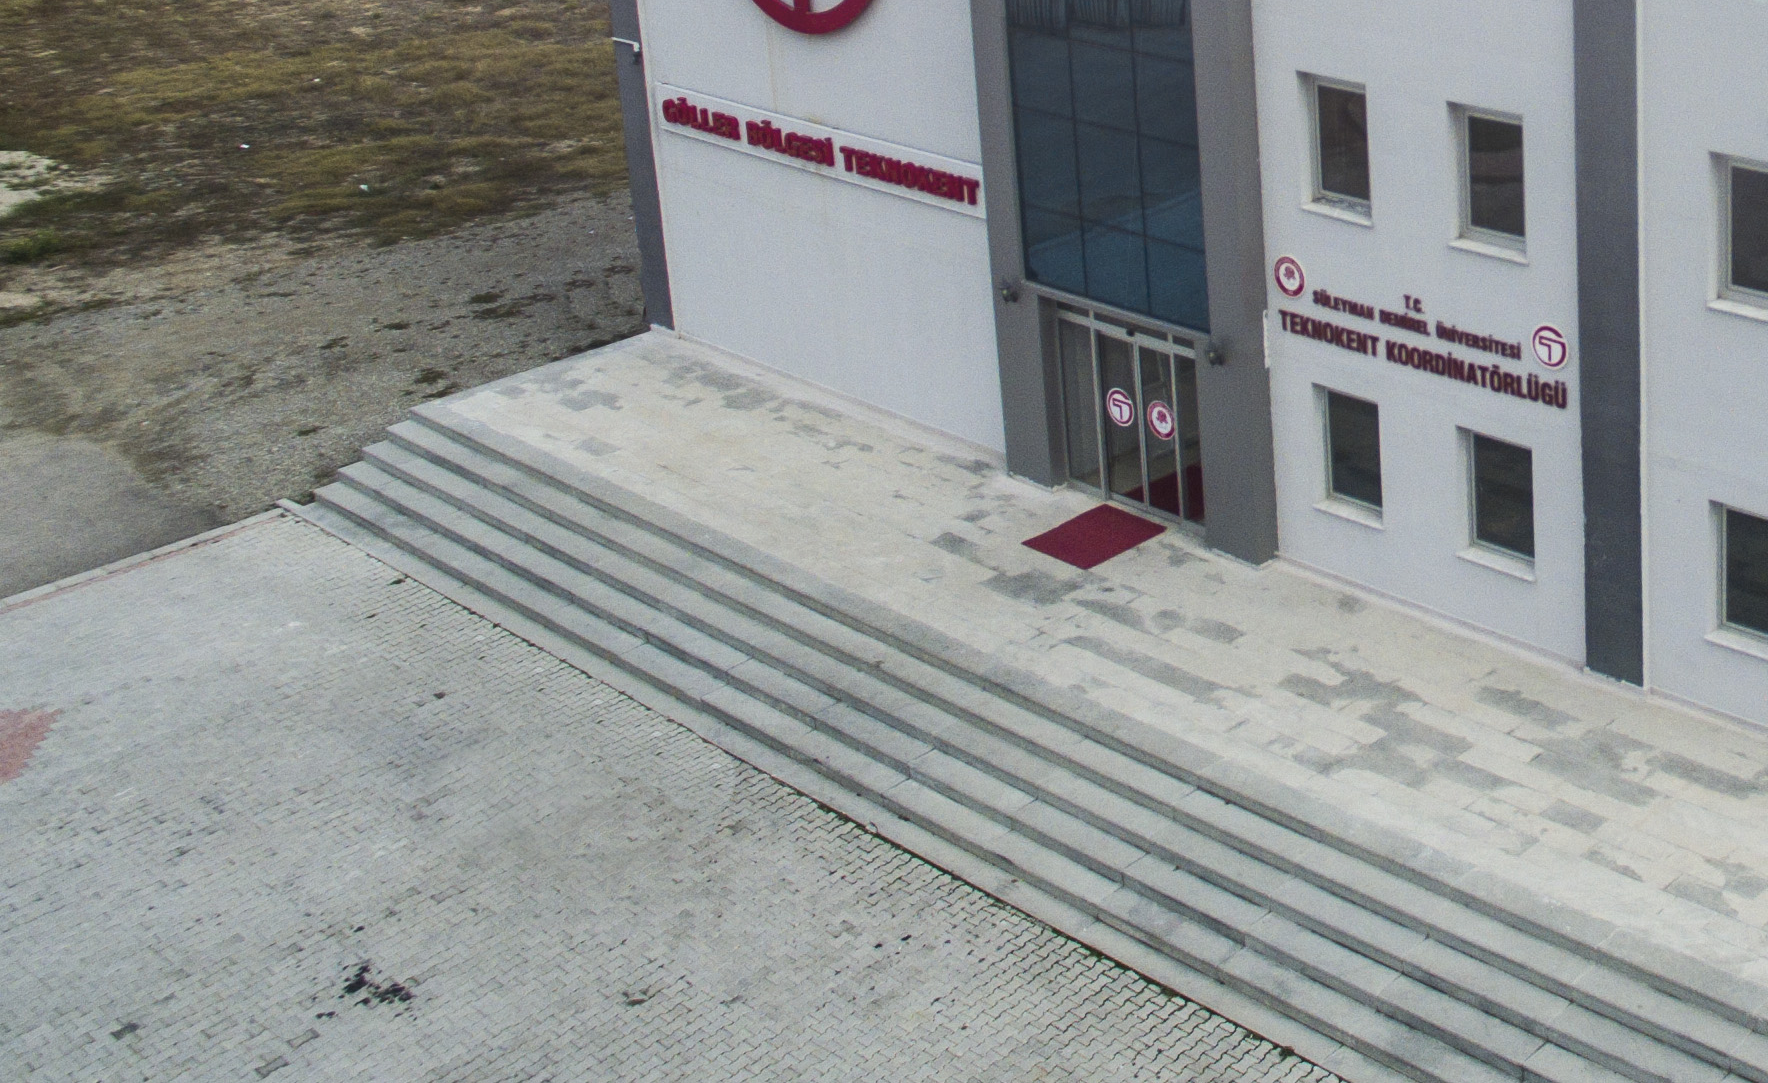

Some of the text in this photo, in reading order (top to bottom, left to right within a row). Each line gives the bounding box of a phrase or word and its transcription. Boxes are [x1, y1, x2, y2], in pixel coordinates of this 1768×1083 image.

[662, 96, 981, 207] GÖLLER BÖLGESİ TEKNOKENT
[1277, 308, 1380, 358] TEKNOKENT
[1311, 288, 1523, 361] SÜLEYMAN DEMİREL ÜNİVERSİTESİ
